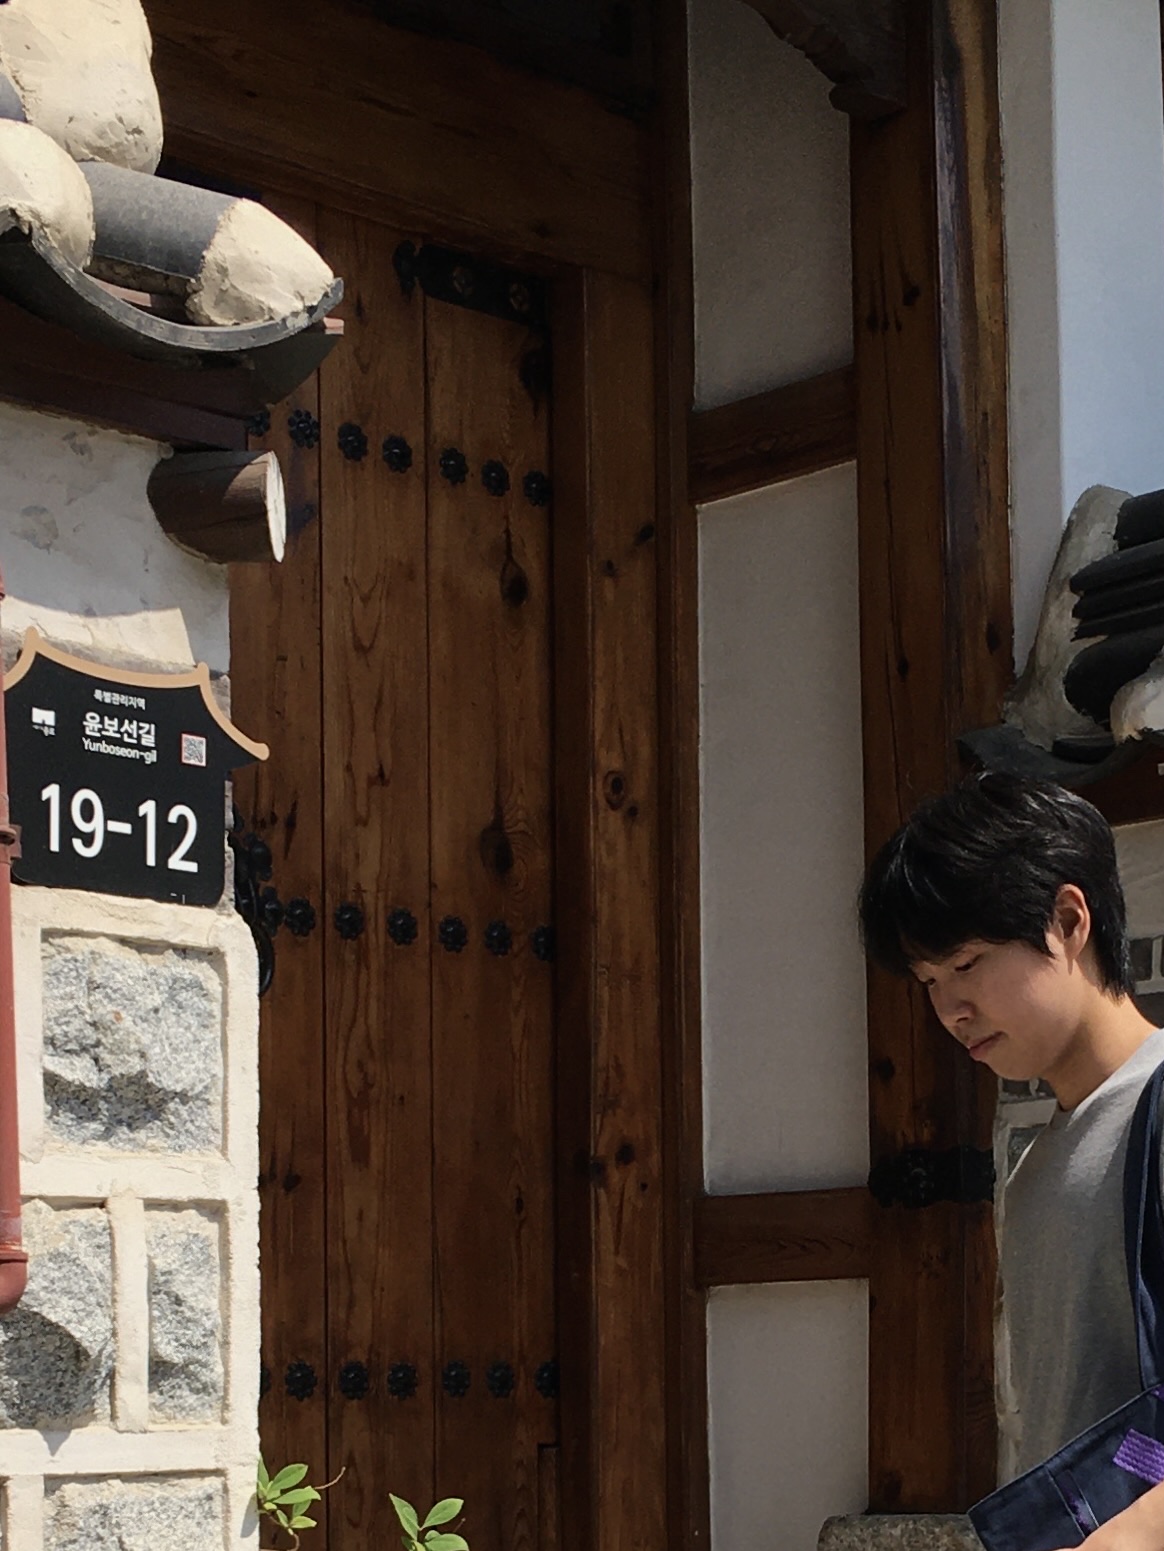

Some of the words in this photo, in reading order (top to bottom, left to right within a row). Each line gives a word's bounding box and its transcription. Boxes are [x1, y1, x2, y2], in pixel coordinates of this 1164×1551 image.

[82, 711, 156, 747] 윤보선길
[82, 737, 157, 764] Yunboseon-gil
[41, 782, 199, 873] 19-12
